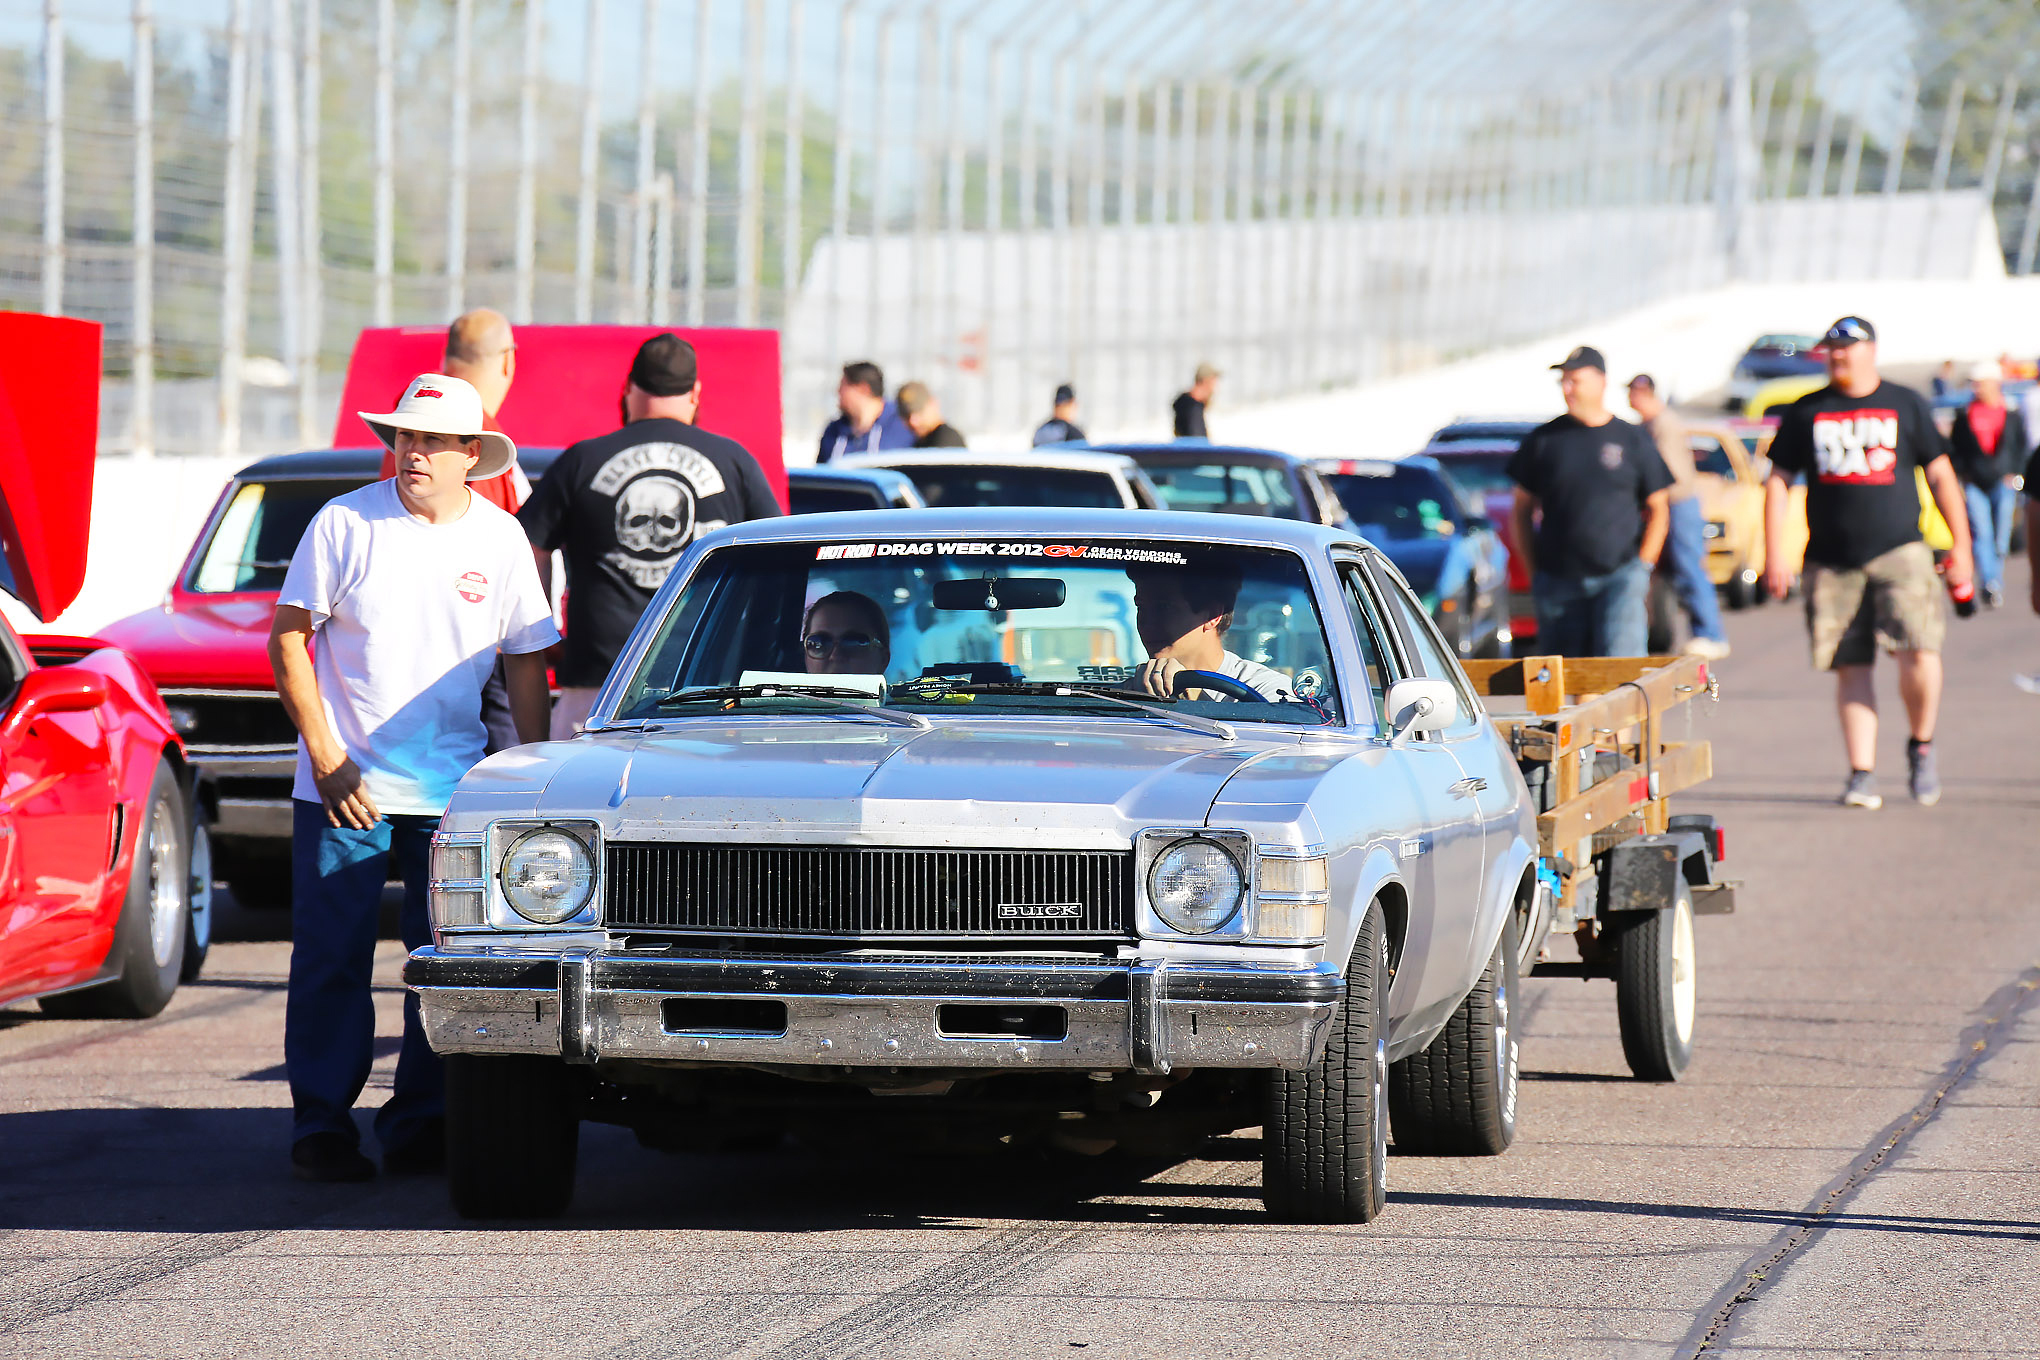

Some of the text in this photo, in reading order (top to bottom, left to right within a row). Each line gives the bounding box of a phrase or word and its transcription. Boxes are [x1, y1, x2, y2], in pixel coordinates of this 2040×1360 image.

[1813, 416, 1898, 449] RUN
[816, 542, 1044, 560] HOT ROD DRAG WEEK 2012
[1091, 546, 1123, 554] GEAR
[1001, 905, 1078, 916] BUICK
